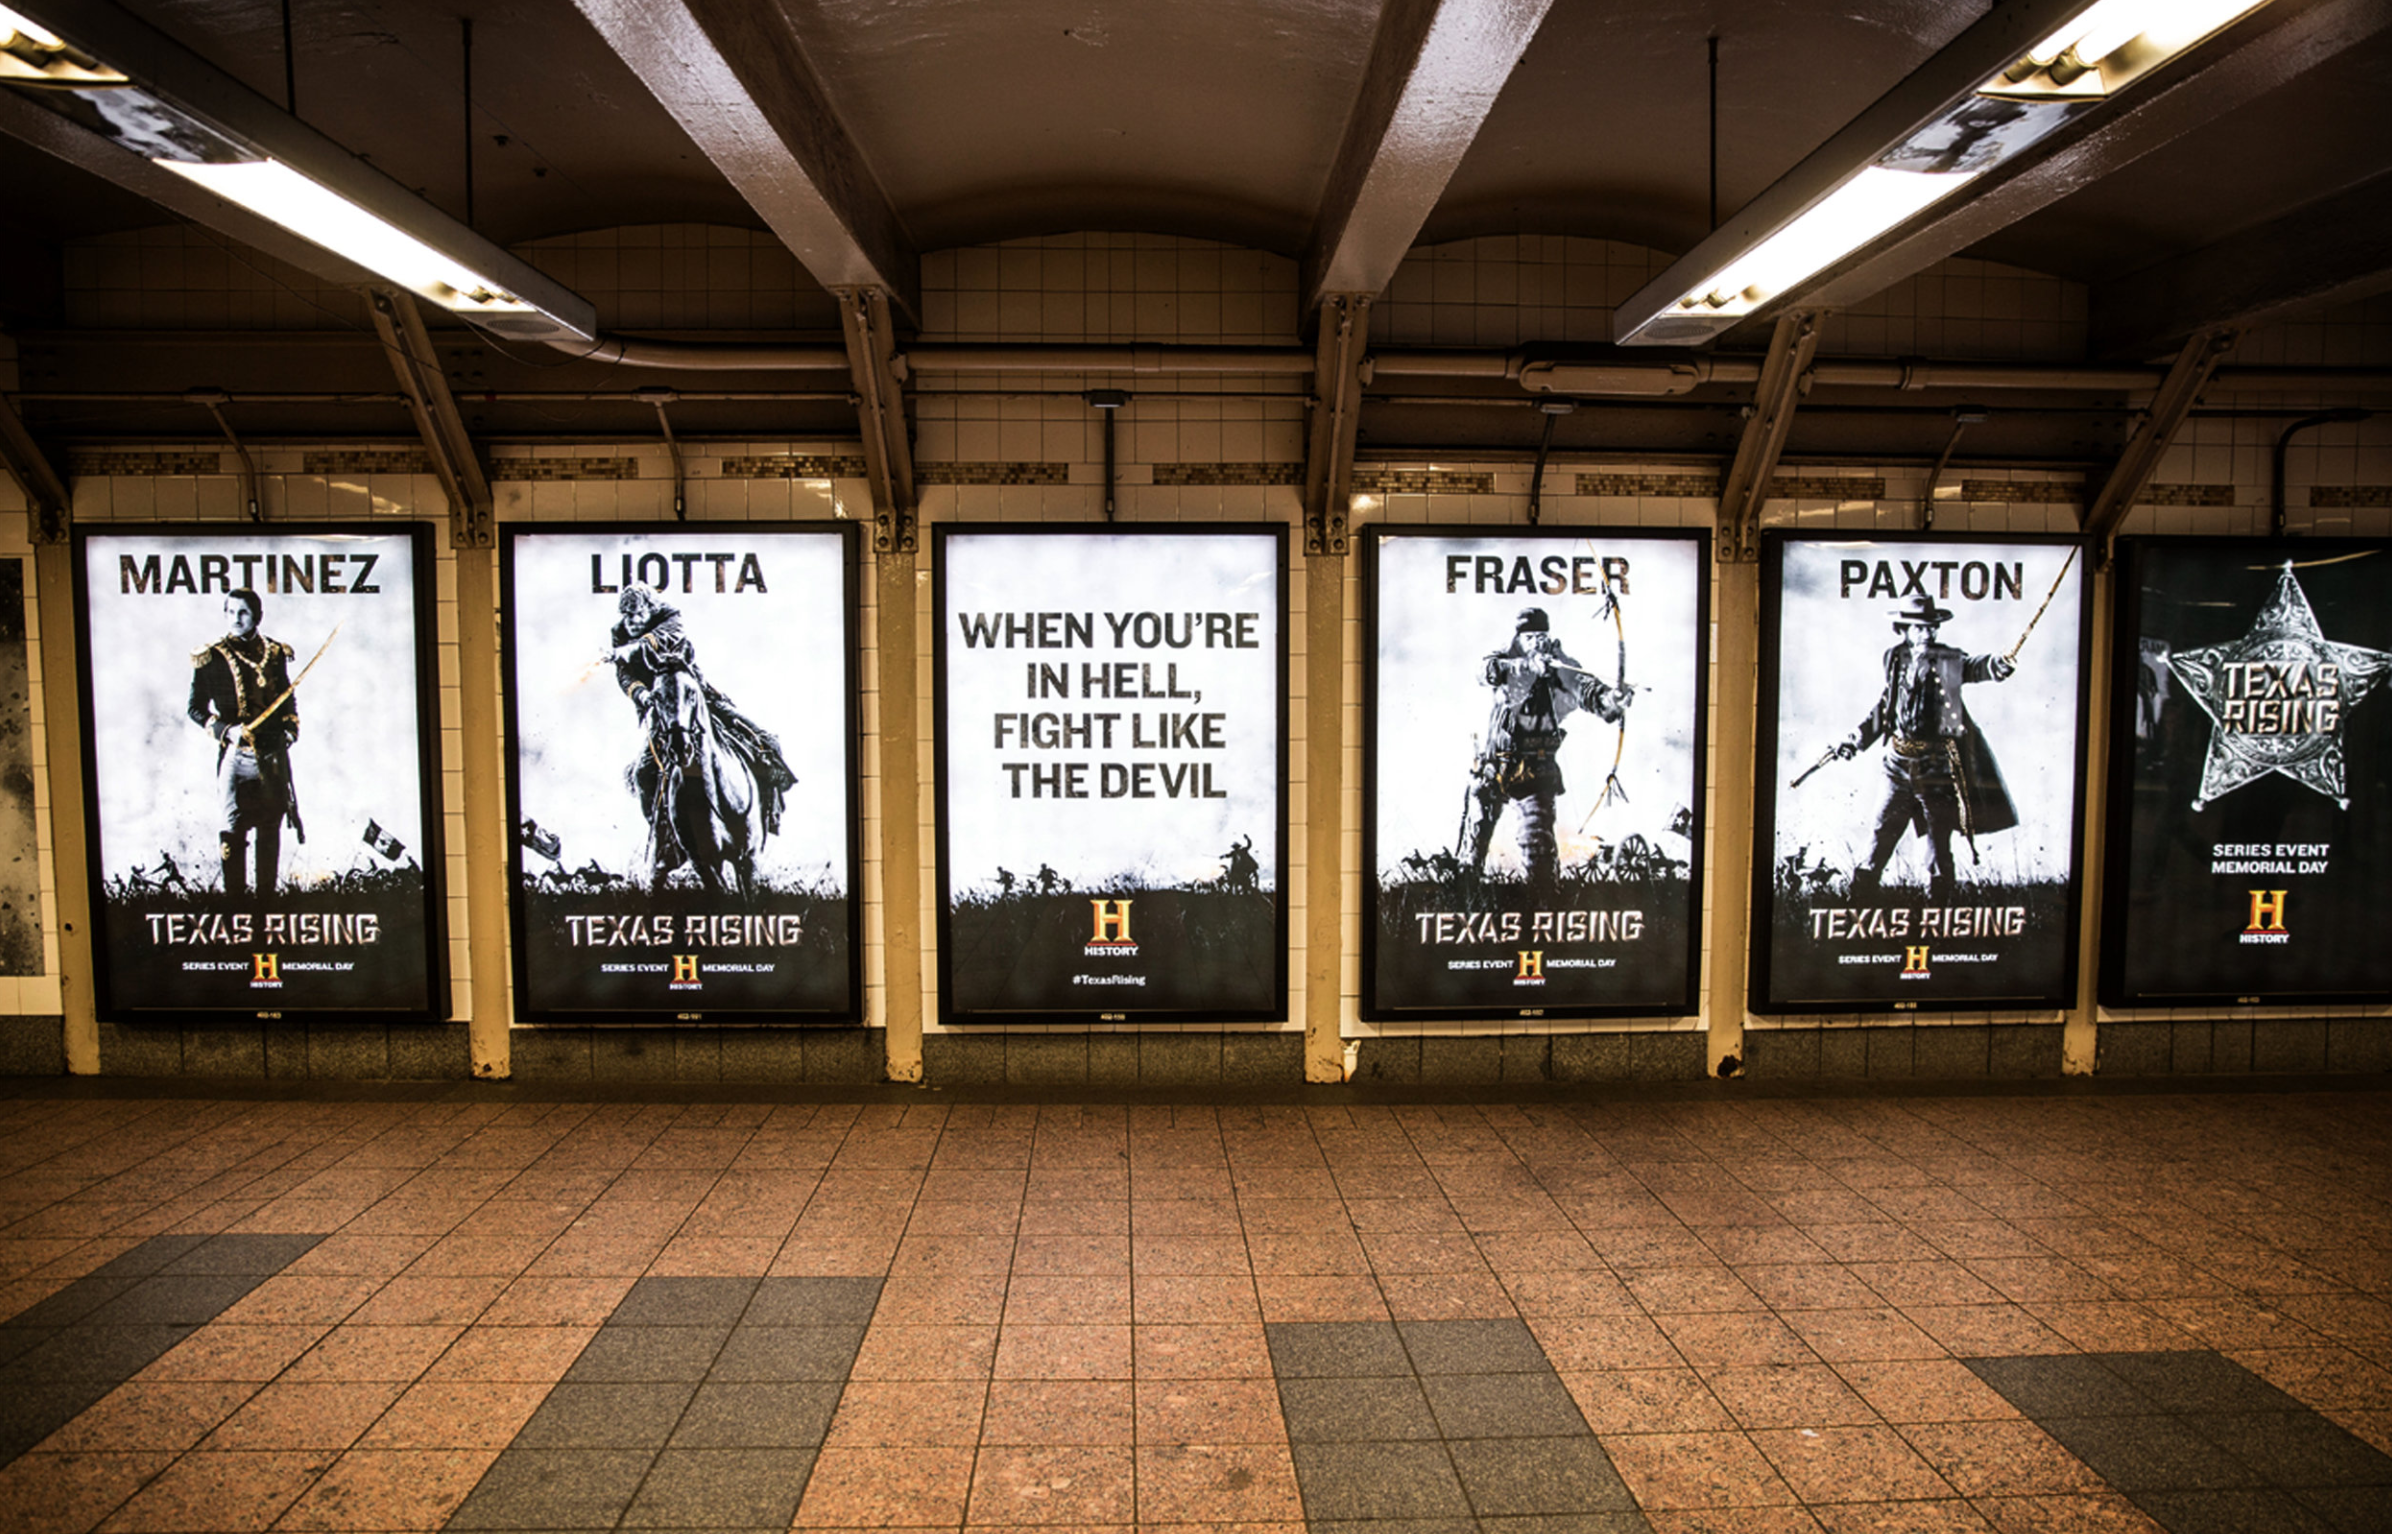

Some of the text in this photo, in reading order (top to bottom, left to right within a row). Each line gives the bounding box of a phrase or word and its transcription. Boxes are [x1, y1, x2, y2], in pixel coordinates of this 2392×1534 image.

[119, 554, 380, 594] MARTINEZ
[591, 552, 768, 594] LIOTTA
[1446, 555, 1631, 595] FRASER
[1840, 560, 2024, 600] PAXTON
[958, 612, 1259, 649] WHEN YOU'RE
[1027, 663, 1202, 704] IN HELL,
[2222, 661, 2339, 700] TEXAS
[994, 713, 1226, 749] FIGHT LIKE
[2223, 699, 2340, 736] RISING
[1002, 763, 1227, 799] THE DEVIL
[2212, 844, 2330, 857] SERIES EVENT
[2211, 861, 2329, 873] MEMORIAL DAY
[1090, 900, 1134, 942] H
[1809, 906, 2027, 939] TEXAS RISING
[2246, 890, 2288, 930] H
[146, 914, 381, 945] TEXAS RISING
[565, 915, 803, 946] TEXAS RISING
[1415, 910, 1645, 944] TEXAS RISING
[2239, 934, 2290, 944] HISTORY
[1084, 946, 1139, 956] HISTORY
[1448, 960, 1514, 969] SERIES EVENT
[1517, 951, 1544, 977] H
[1546, 959, 1616, 968] MEMORIAL DAY
[1838, 954, 1902, 964] SERIES EVENT
[1905, 945, 1930, 971] H
[1932, 954, 1998, 962] MEMORIAL DAY
[182, 962, 249, 971] SERIES EVENT
[252, 953, 278, 980] H
[282, 962, 355, 971] MEMORIAL DAY
[601, 964, 669, 972] SERIES EVENT
[672, 954, 699, 981] H
[702, 964, 775, 972] MEMORIAL DAY
[1072, 974, 1146, 986] #TexasRising
[1900, 972, 1931, 980] HISTORY
